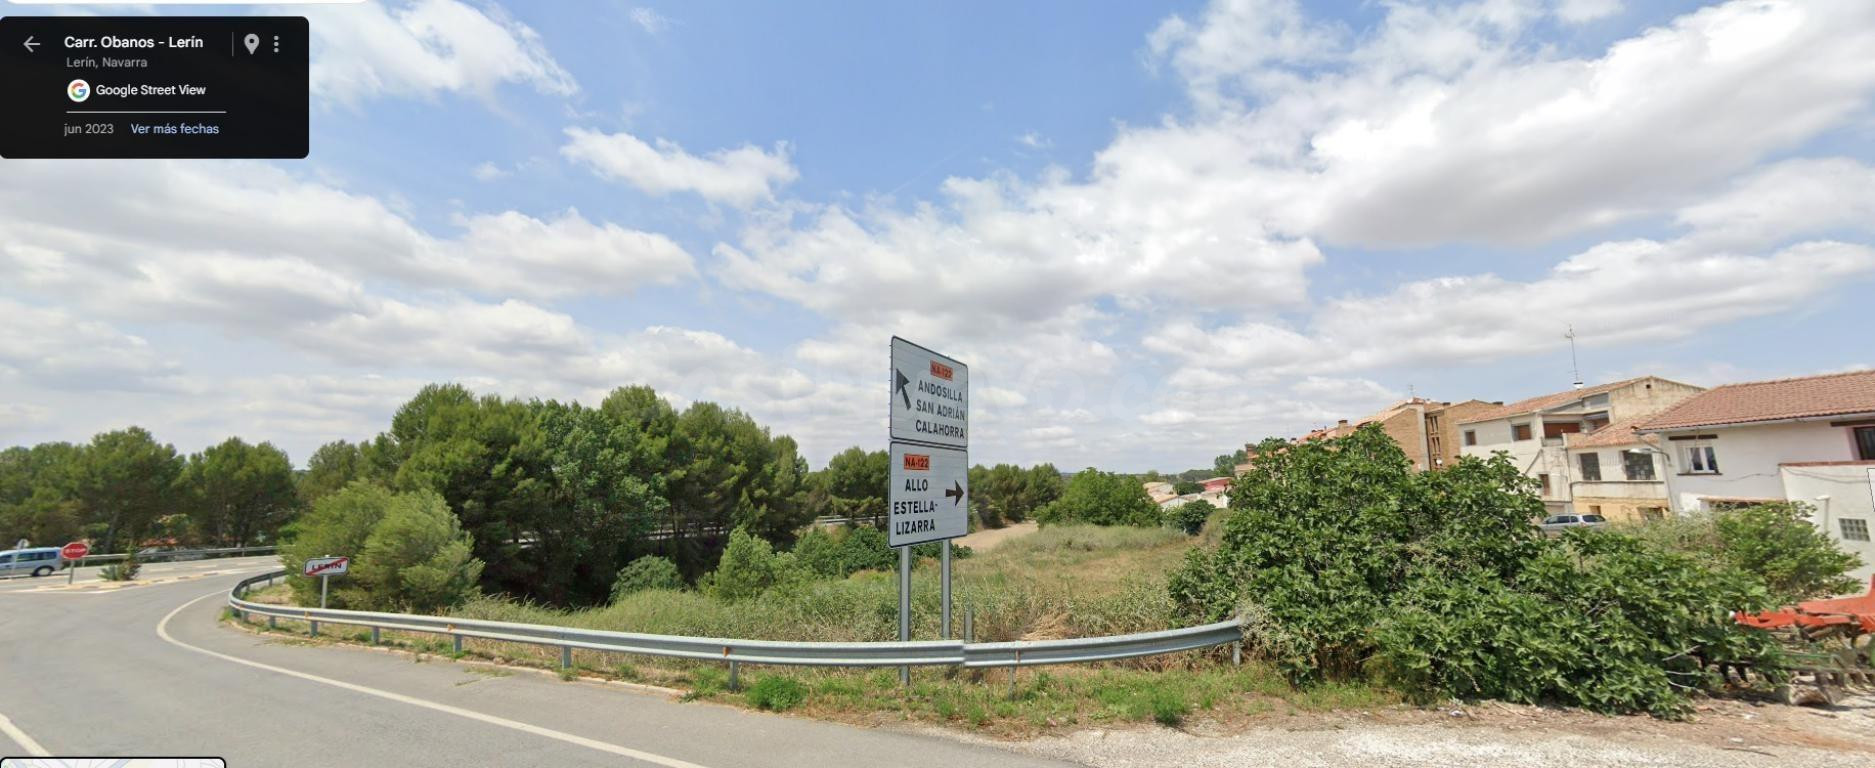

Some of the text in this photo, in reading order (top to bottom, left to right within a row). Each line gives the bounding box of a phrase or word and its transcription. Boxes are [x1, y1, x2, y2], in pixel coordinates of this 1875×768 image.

[918, 379, 963, 403] ANDOSILLA
[916, 399, 965, 421] SAN ADRIÁN
[915, 419, 965, 439] CALAHORRA
[905, 457, 929, 468] NA-122
[905, 478, 929, 493] ALLO
[893, 500, 938, 515] ESTELLA-
[896, 518, 936, 536] LIZARRA
